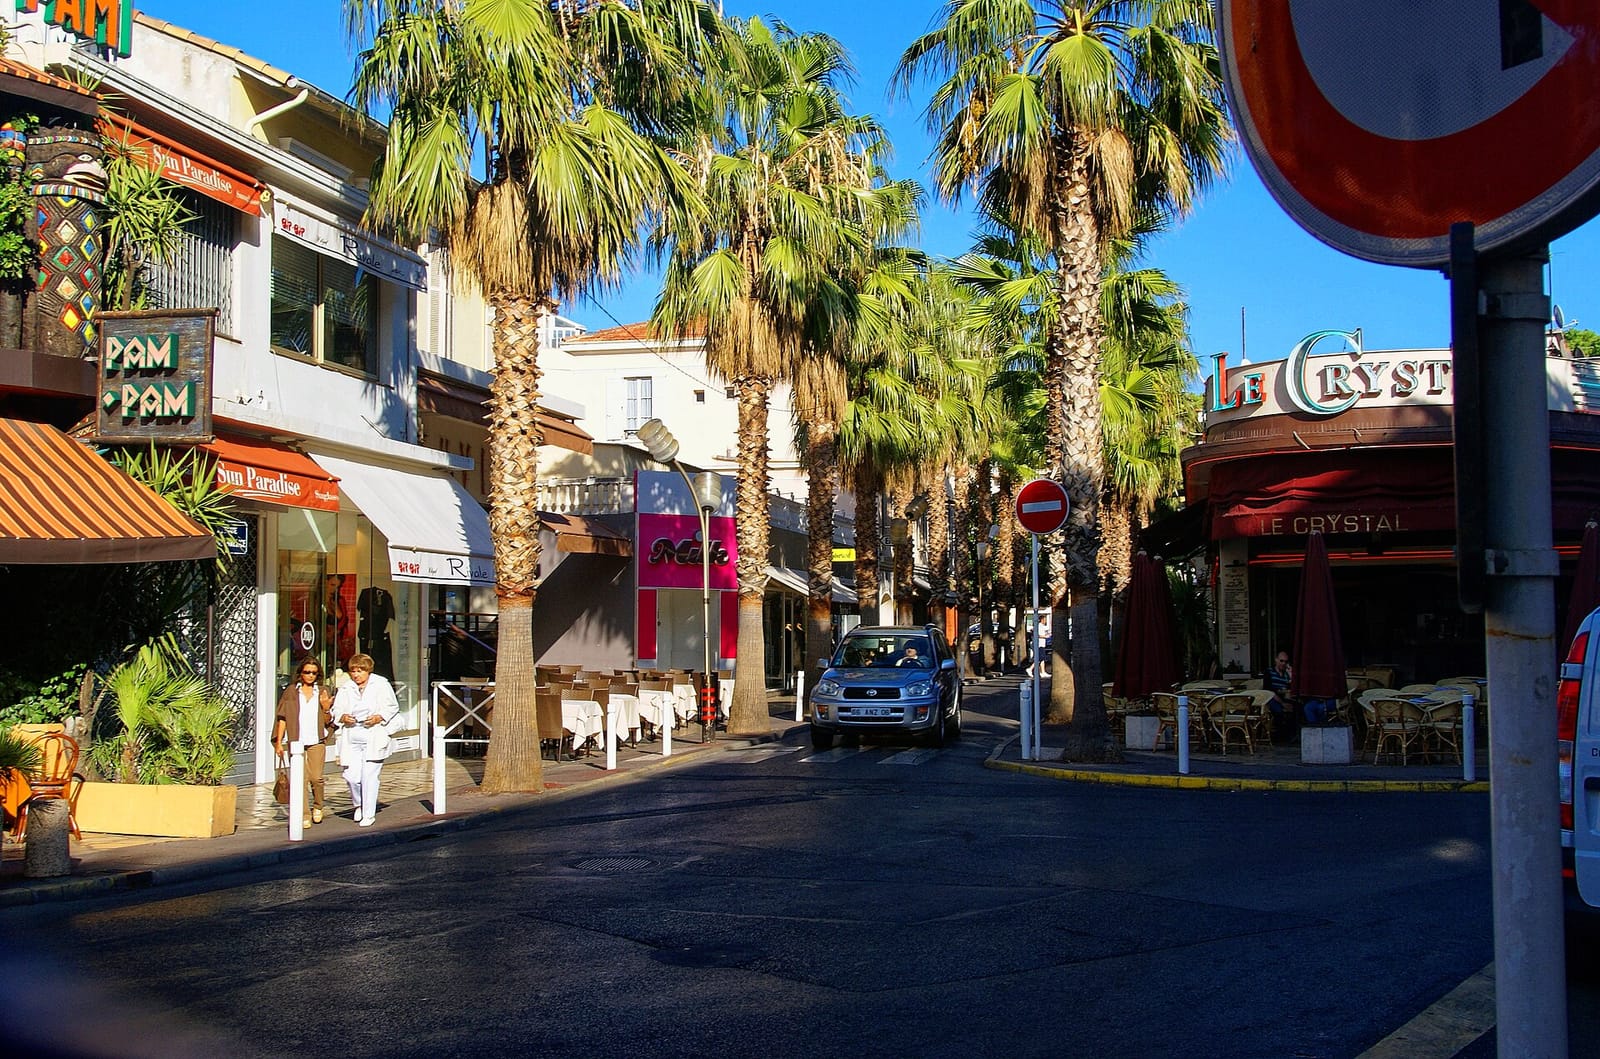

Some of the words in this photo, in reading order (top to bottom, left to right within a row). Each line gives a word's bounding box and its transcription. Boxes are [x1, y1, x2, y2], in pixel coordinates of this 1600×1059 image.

[16, 0, 131, 58] AM
[180, 155, 232, 194] Paradise
[104, 333, 179, 369] PAM
[1285, 328, 1452, 415] CRYST
[217, 460, 244, 487] Sun
[246, 466, 302, 496] Paradise
[1260, 518, 1284, 536] LE
[1293, 513, 1409, 535] CRYSTAL
